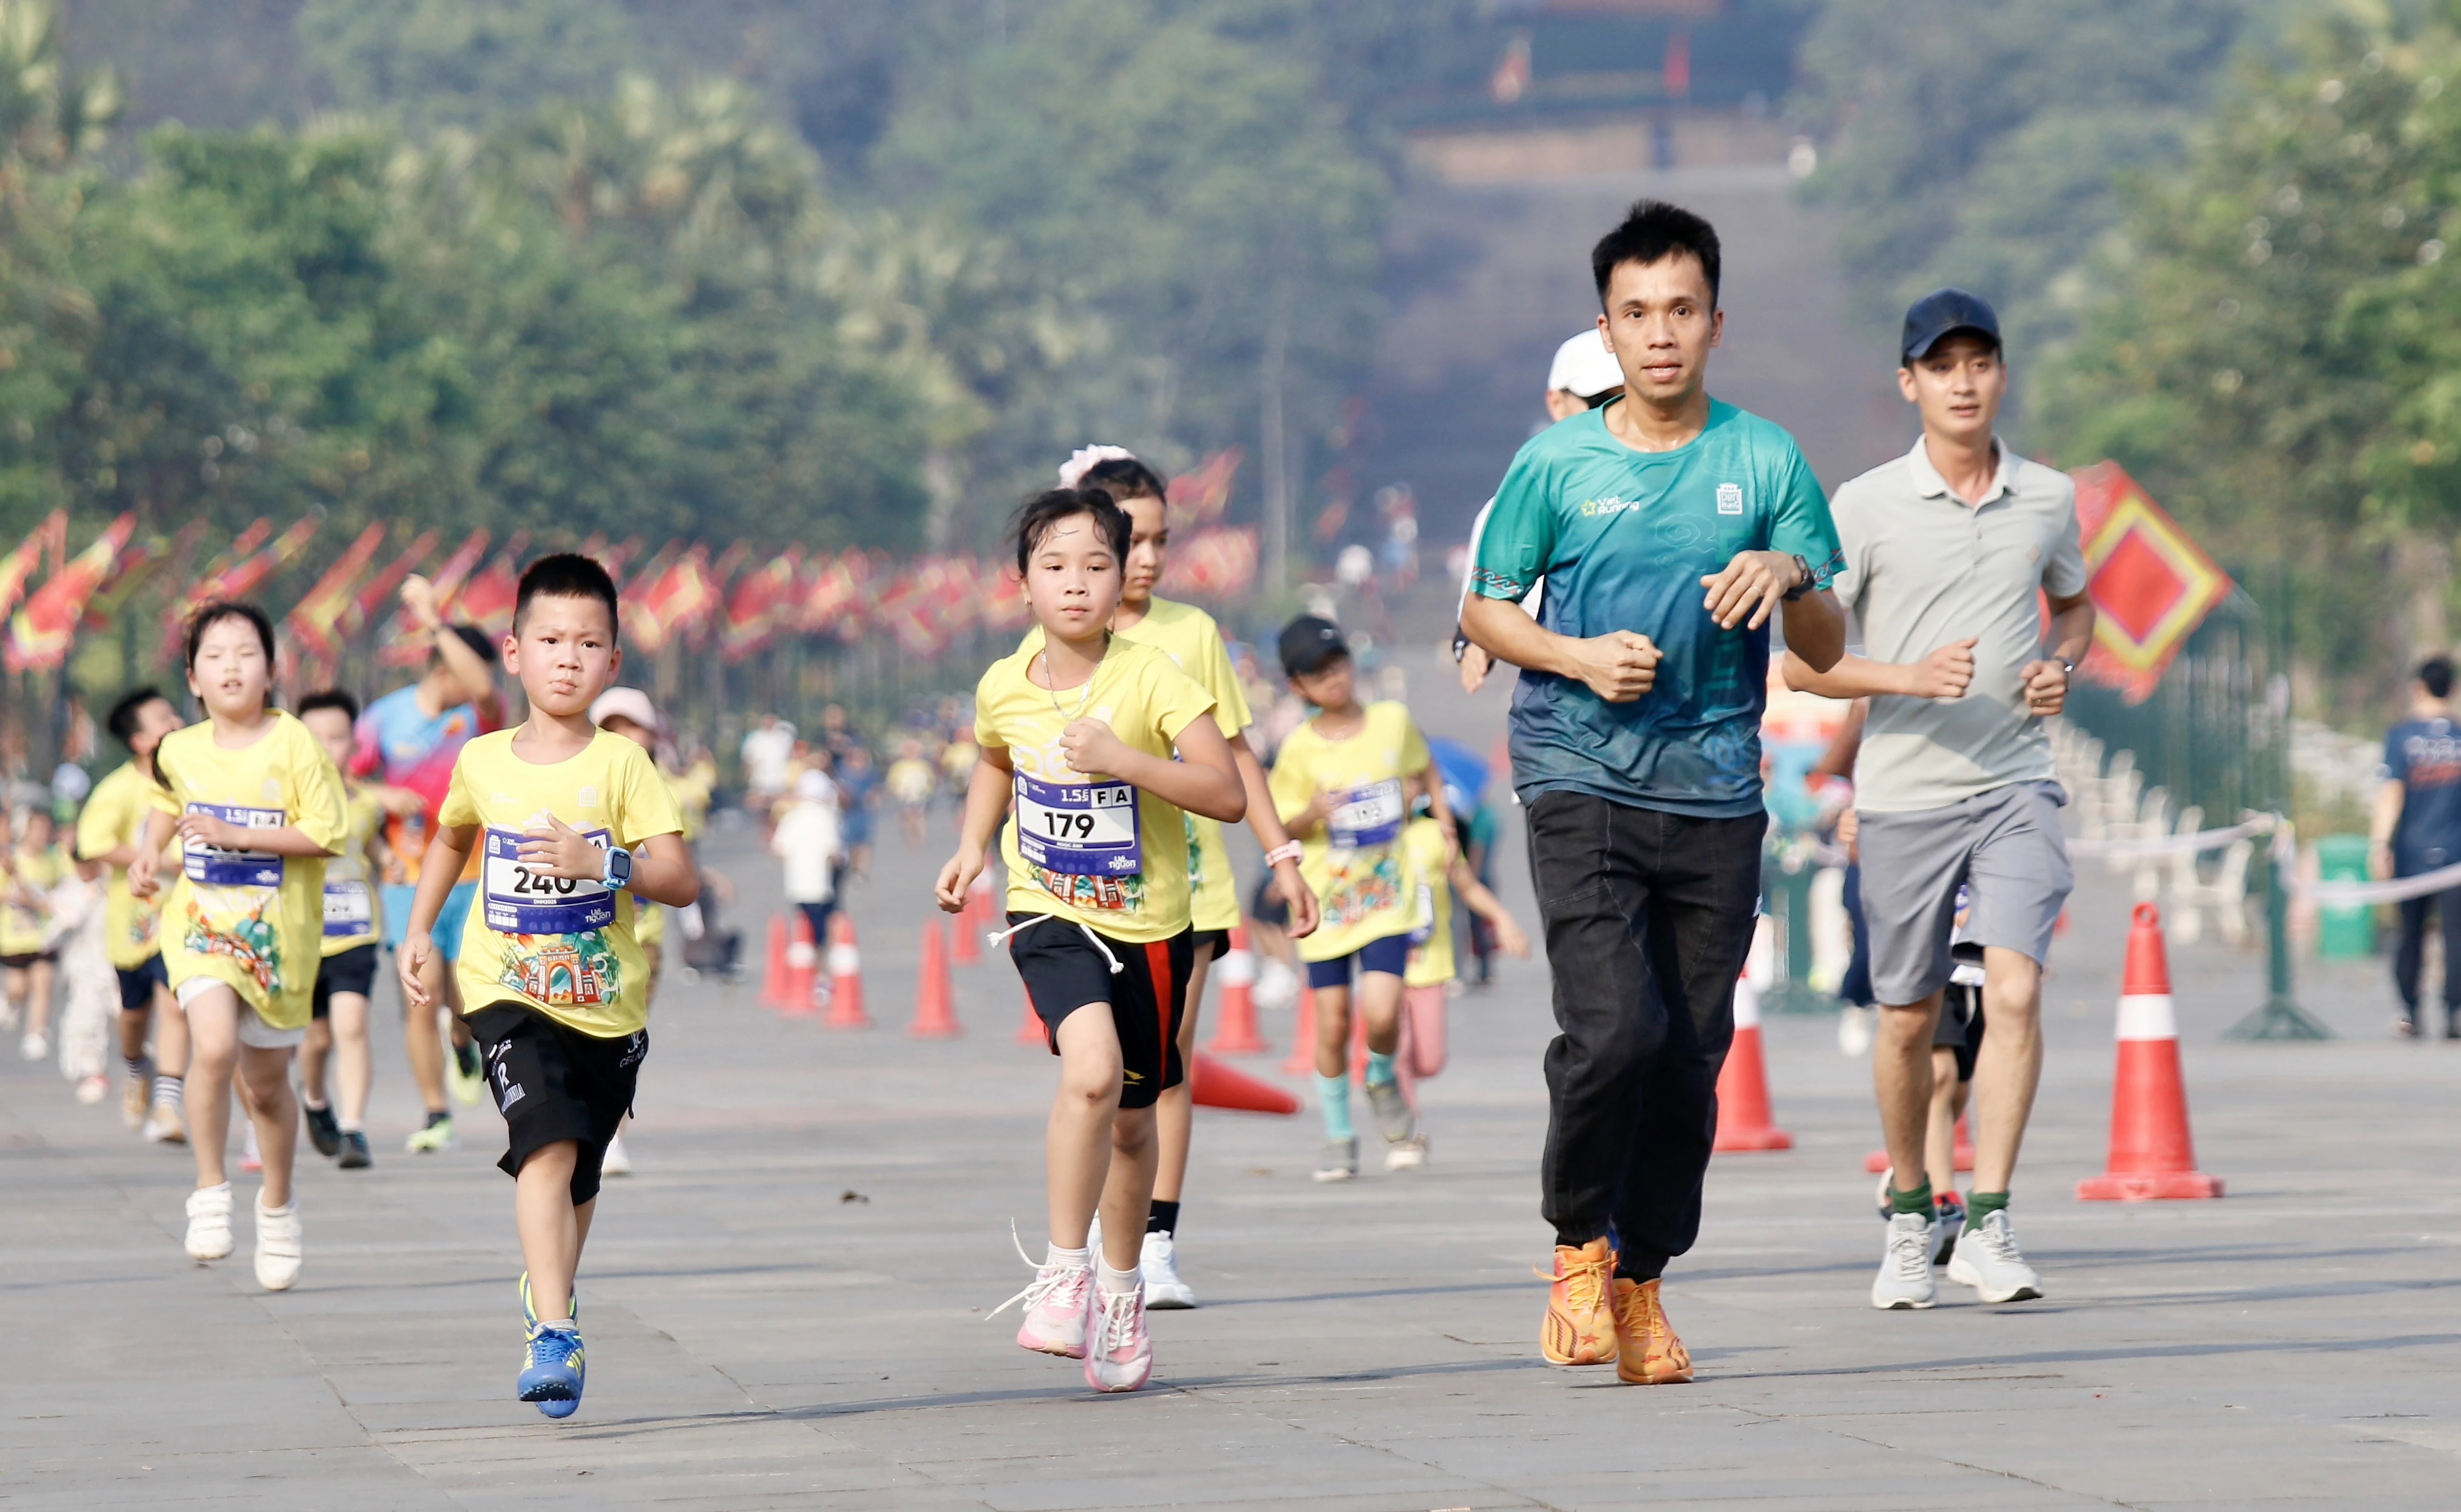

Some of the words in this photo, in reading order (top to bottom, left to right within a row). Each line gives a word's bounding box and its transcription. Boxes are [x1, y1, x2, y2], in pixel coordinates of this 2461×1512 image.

[1061, 788, 1082, 802] 1.5
[1097, 791, 1106, 804] F
[1115, 789, 1128, 803] A
[1044, 812, 1095, 839] 179
[514, 866, 577, 894] 240
